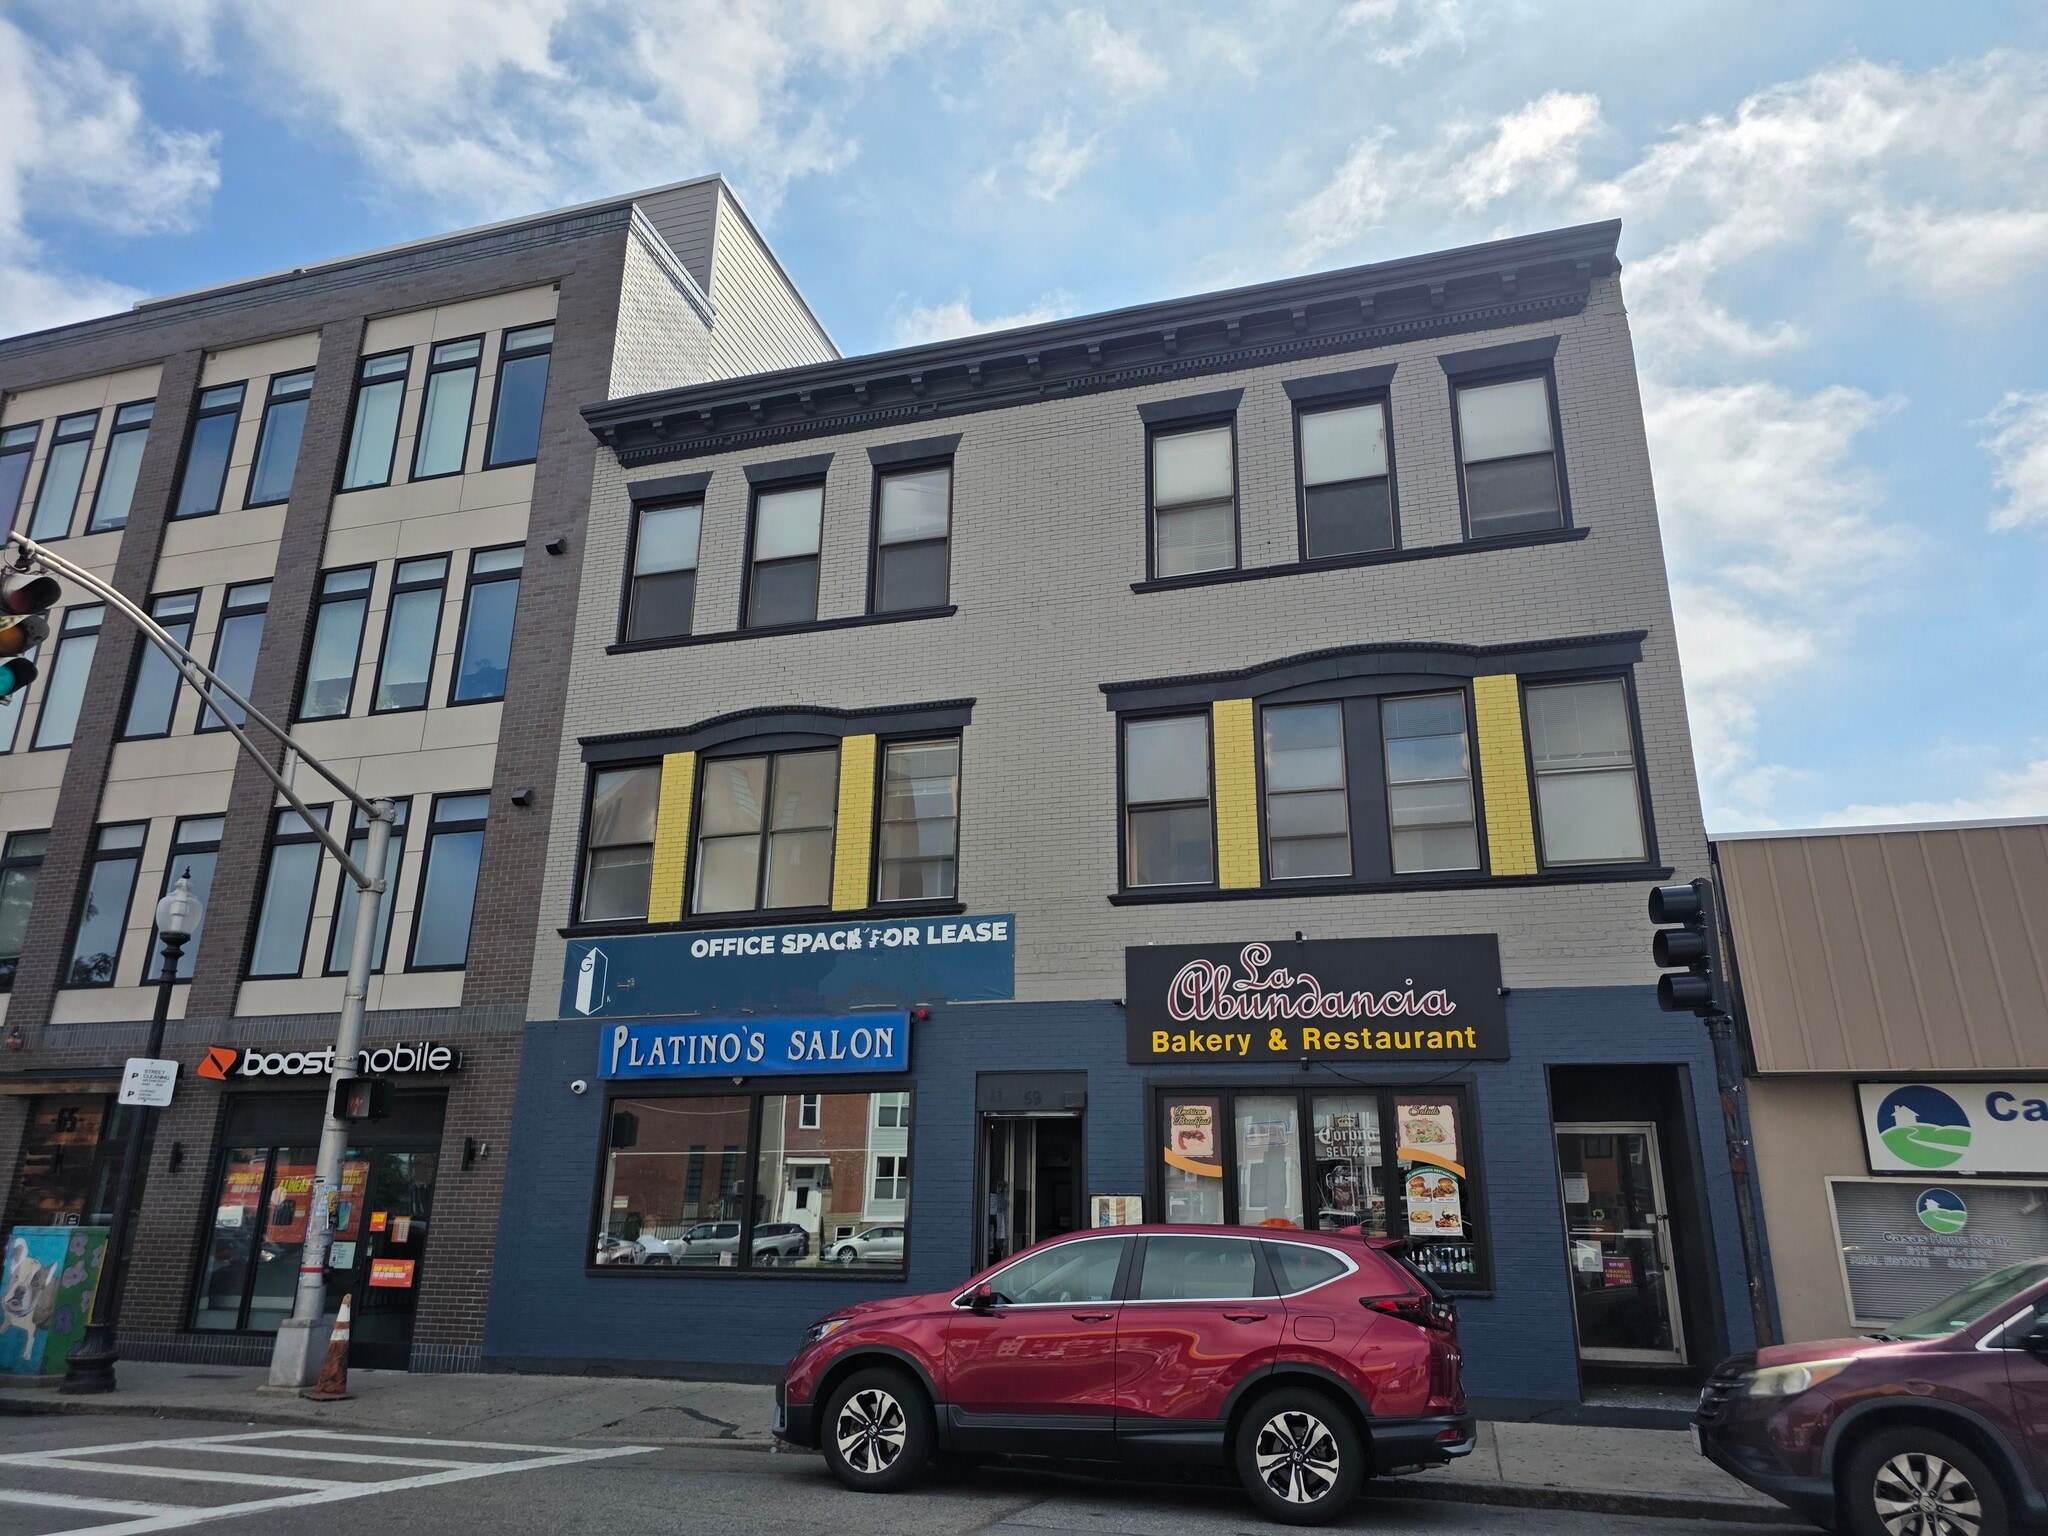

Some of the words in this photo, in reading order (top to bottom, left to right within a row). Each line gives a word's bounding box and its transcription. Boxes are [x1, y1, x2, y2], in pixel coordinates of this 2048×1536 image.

[691, 935, 775, 958] OFFICE
[868, 927, 920, 949] FOR
[926, 921, 1008, 944] LEASE
[1233, 943, 1295, 991] La
[1167, 959, 1457, 1021] Abundancia
[788, 1027, 894, 1061] SALON
[1152, 1029, 1252, 1056] Bakery
[1268, 1028, 1288, 1051] &
[1302, 1026, 1477, 1050] Restaurant
[1173, 1106, 1208, 1117] American
[1408, 1104, 1440, 1117] Salads
[1985, 1090, 2048, 1122] Ca
[1173, 1115, 1213, 1129] Breakfast
[1319, 1125, 1377, 1148] Corona
[1326, 1146, 1373, 1158] SELTZER
[1883, 1232, 1927, 1244] Casas
[1930, 1233, 1968, 1245] Home
